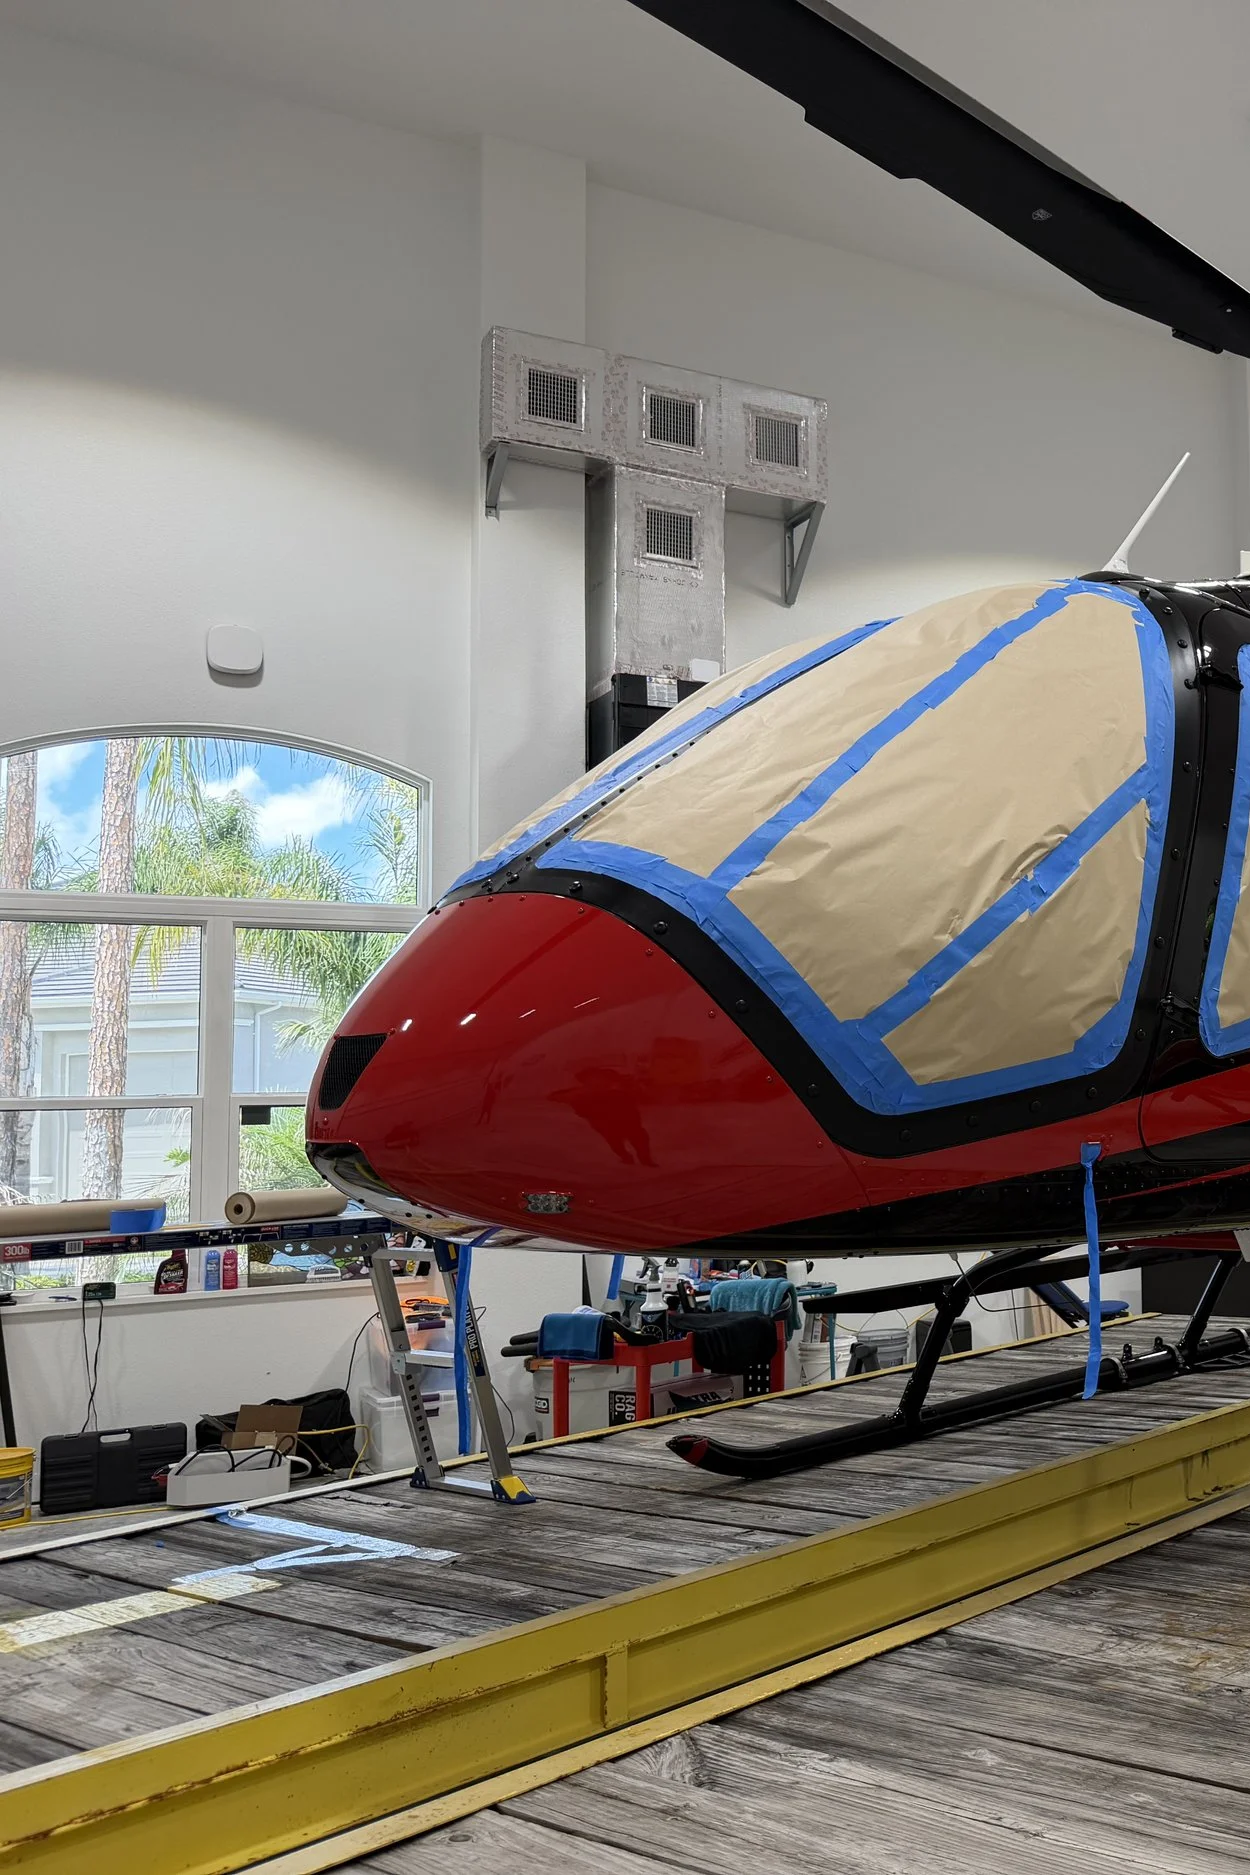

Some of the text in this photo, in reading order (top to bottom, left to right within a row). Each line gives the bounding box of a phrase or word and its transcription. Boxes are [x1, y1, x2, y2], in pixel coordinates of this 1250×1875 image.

[4, 1245, 30, 1257] 300lb
[468, 1333, 478, 1350] PRO
[614, 1394, 625, 1416] CO.
[624, 1395, 636, 1421] RAG
